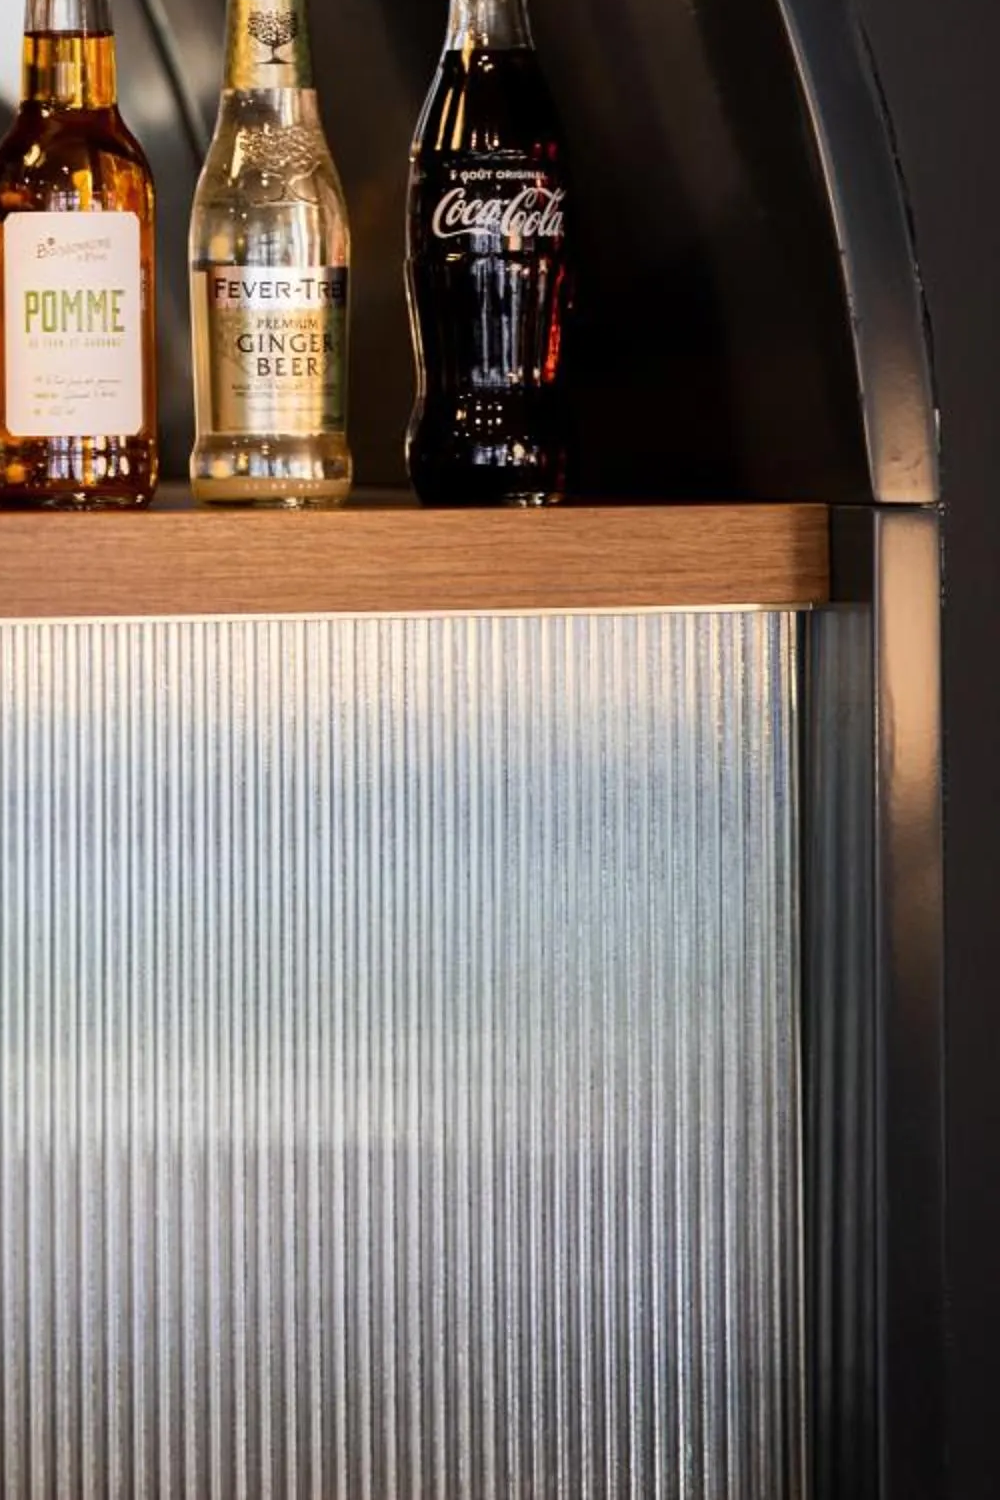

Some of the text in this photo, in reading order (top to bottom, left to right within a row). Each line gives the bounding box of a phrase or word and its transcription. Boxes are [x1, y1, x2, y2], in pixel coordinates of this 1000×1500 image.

[432, 187, 566, 239] Coca-Cola
[214, 277, 345, 300] FEVER-TRE
[23, 289, 126, 334] POMME
[236, 333, 334, 353] GINGER
[256, 358, 320, 377] BEER
